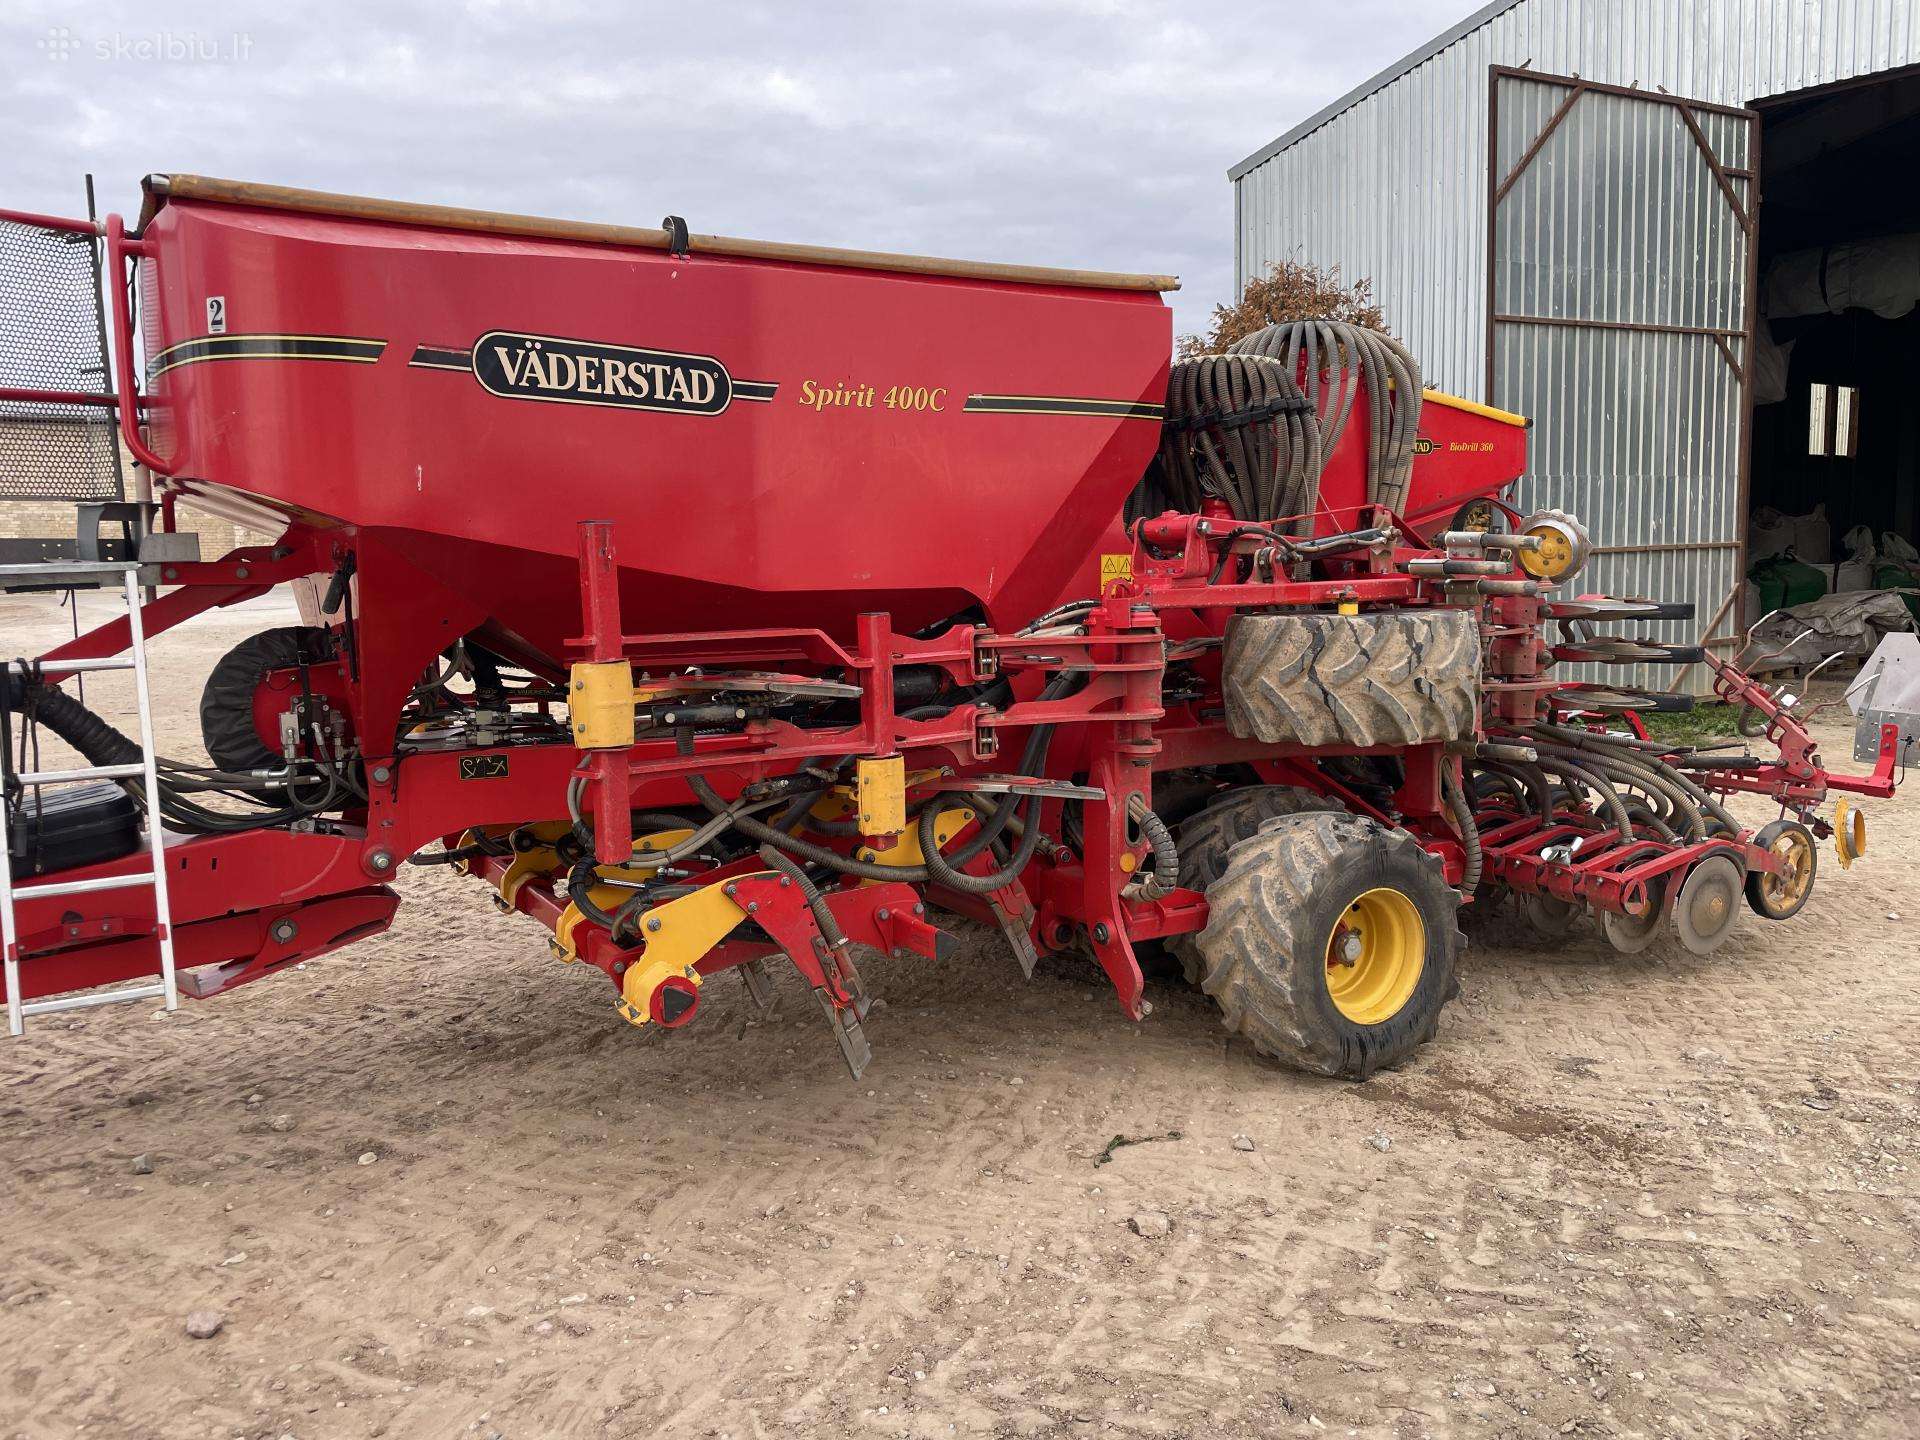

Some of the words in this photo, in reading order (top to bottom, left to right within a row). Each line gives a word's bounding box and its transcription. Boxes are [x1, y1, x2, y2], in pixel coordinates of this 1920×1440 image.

[210, 299, 224, 326] 2
[799, 380, 876, 412] Spirit
[882, 385, 948, 412] 400C
[1414, 442, 1430, 452] TAD
[1449, 442, 1479, 452] BioDrill
[1480, 442, 1494, 452] 360
